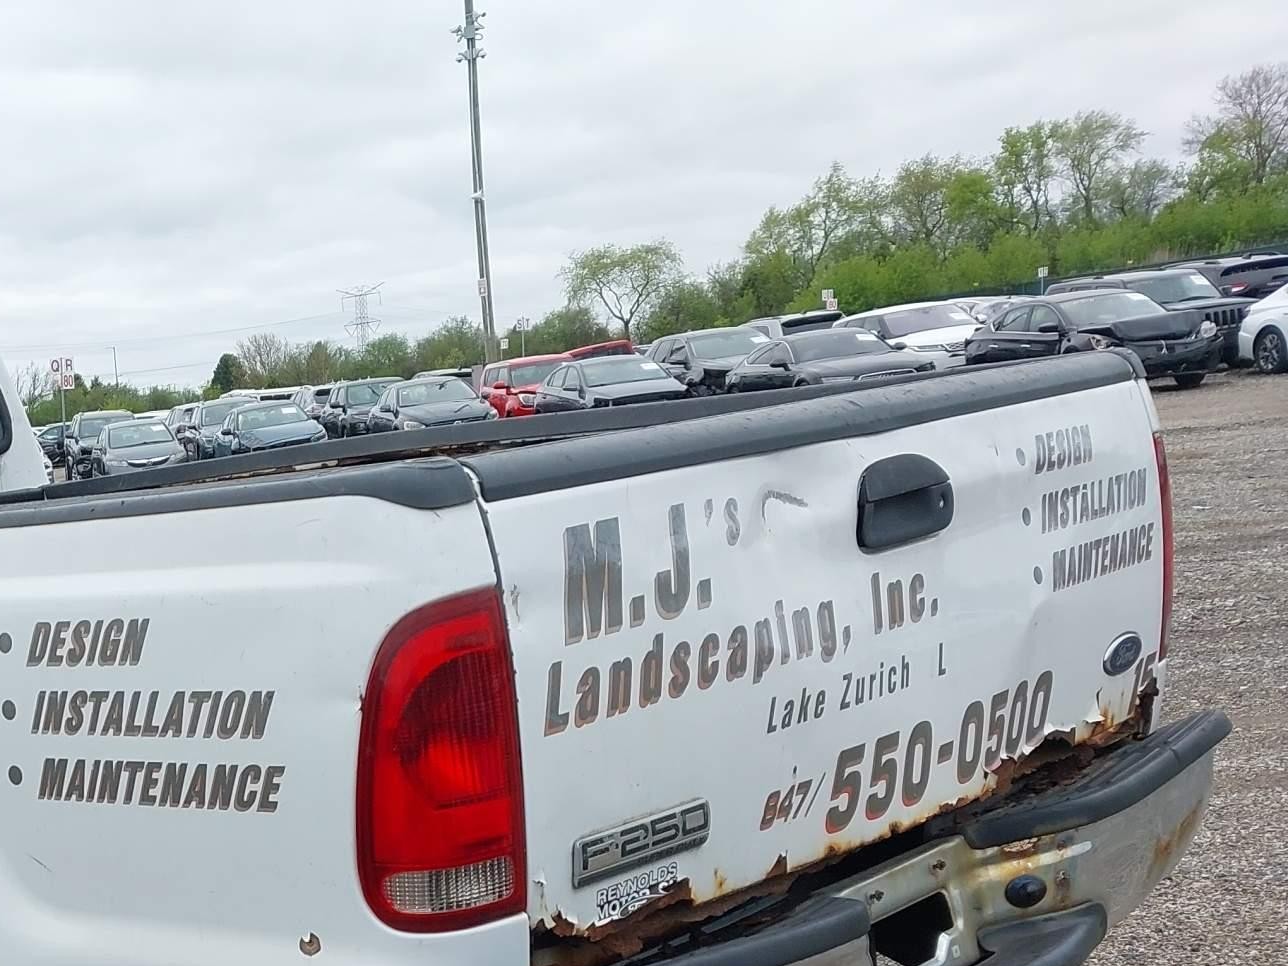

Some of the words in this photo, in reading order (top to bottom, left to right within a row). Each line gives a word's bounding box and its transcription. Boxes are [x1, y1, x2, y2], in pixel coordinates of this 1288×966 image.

[51, 359, 60, 373] Q
[65, 358, 73, 371] R
[63, 374, 74, 388] 80
[1034, 424, 1093, 475] DESIGN
[1041, 467, 1147, 534] INSTALLATION
[1052, 522, 1155, 593] MAINTENANCE
[25, 617, 150, 667] DESIGN
[544, 600, 851, 738] Landscaping,
[870, 571, 938, 635] Inc.
[30, 690, 275, 740] INSTALLATION
[767, 687, 826, 734] Lake
[839, 655, 910, 711] Zurich
[37, 757, 286, 813] MAINTENANCE
[596, 861, 679, 908] REYNOLDS
